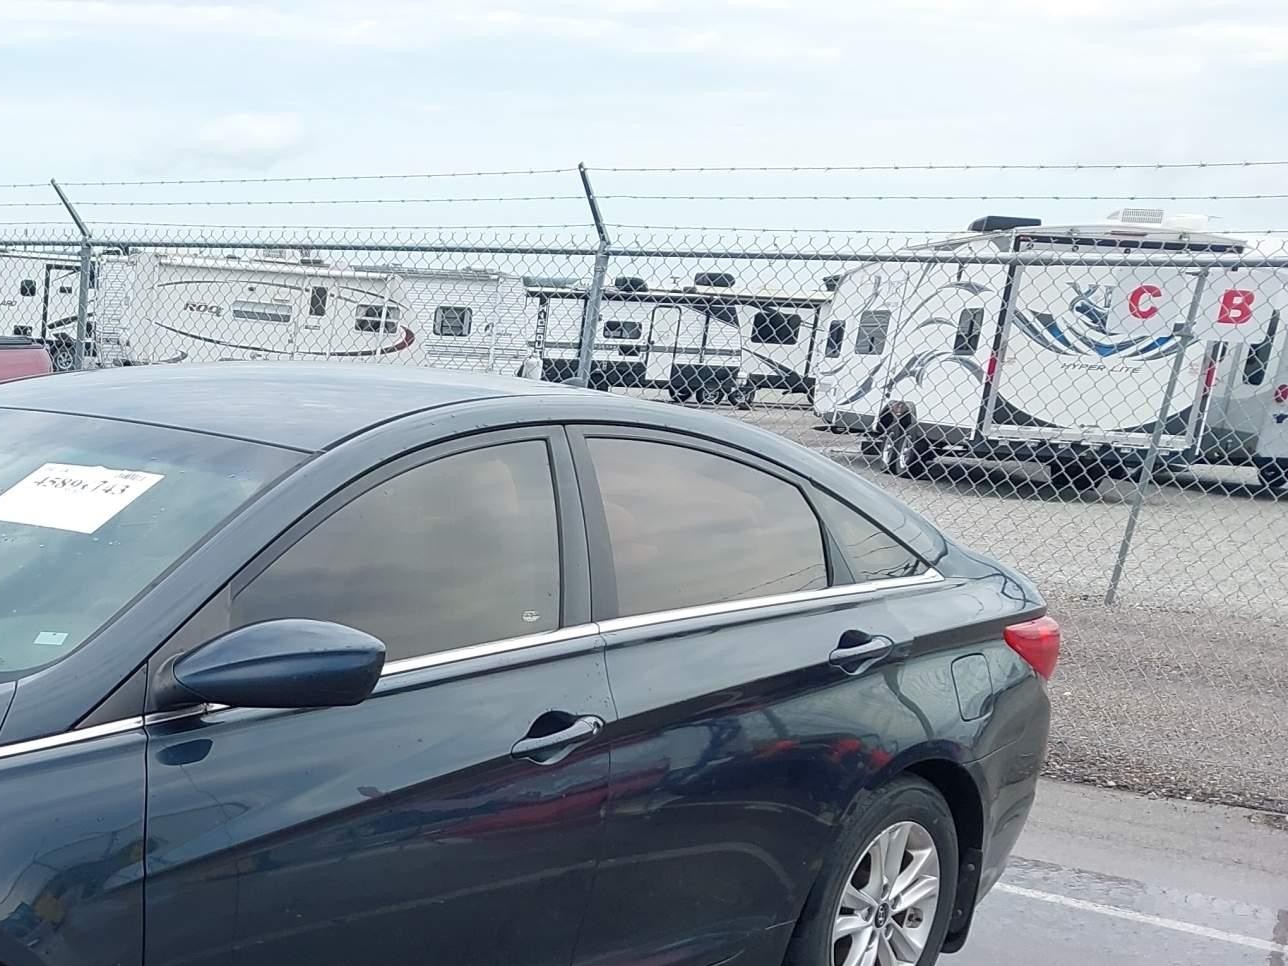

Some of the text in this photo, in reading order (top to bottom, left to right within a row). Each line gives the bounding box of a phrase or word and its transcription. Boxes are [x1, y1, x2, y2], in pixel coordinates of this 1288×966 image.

[1128, 285, 1162, 319] C
[1217, 289, 1255, 324] B
[1061, 363, 1145, 374] HYPER LITE
